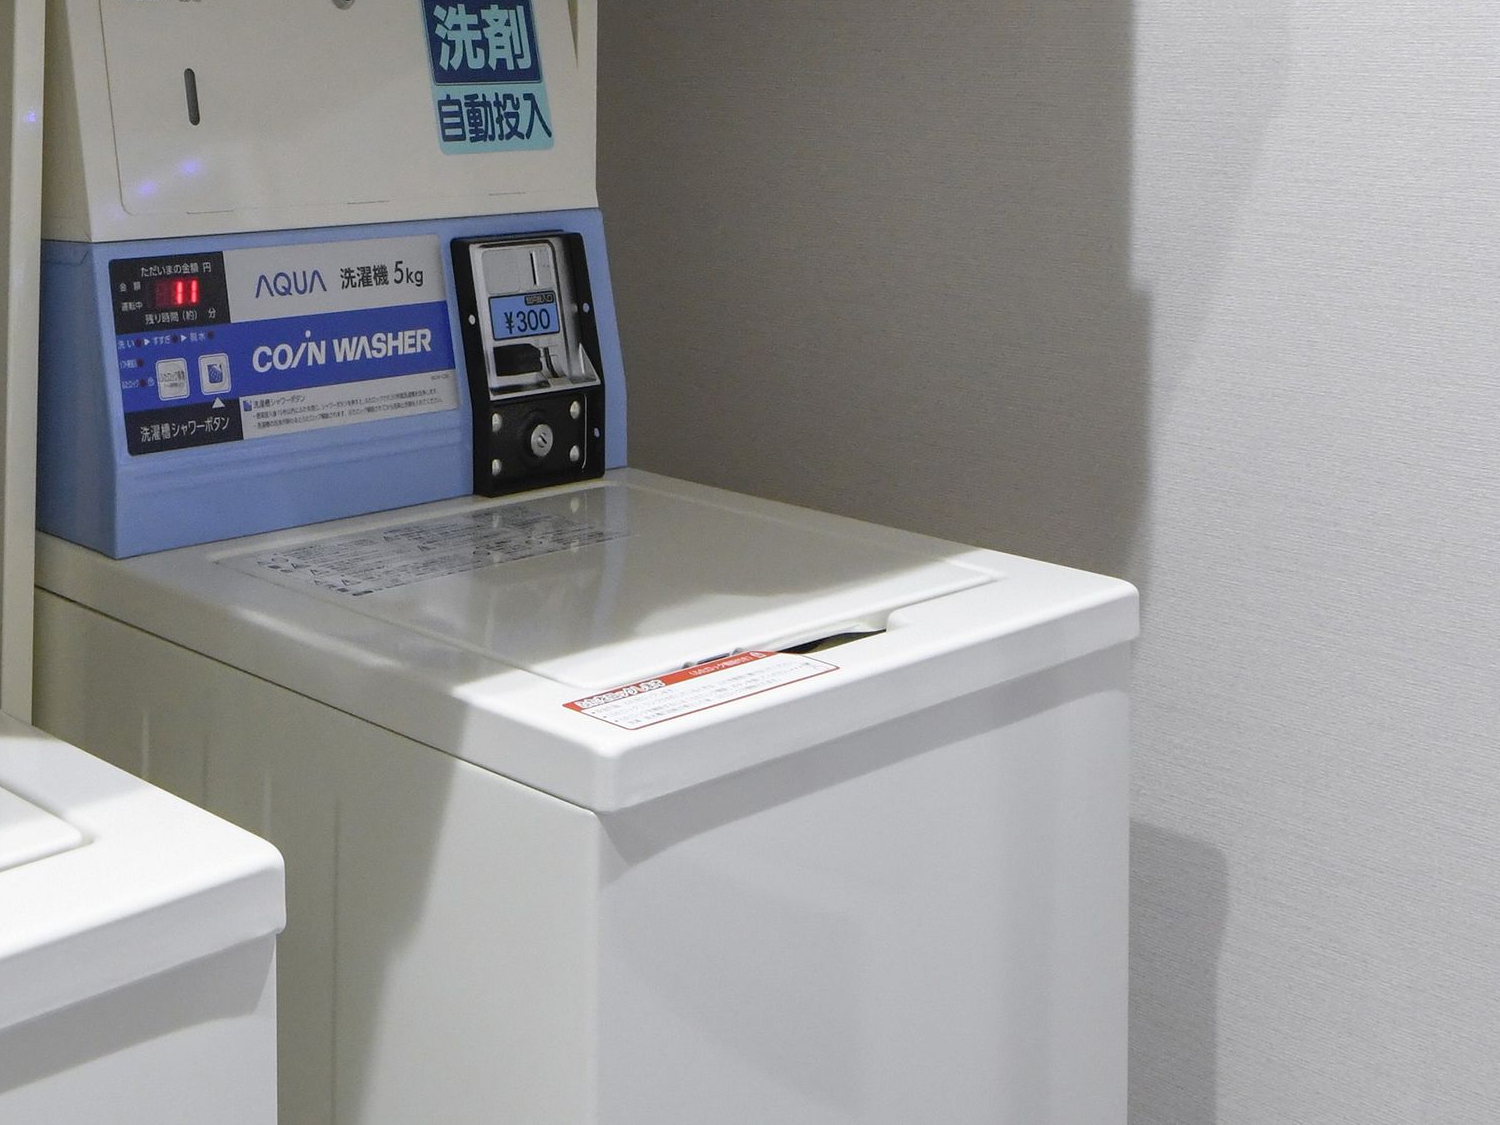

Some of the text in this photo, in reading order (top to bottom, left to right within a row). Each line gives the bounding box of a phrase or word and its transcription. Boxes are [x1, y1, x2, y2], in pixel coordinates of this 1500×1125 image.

[433, 3, 532, 71] 洗剤
[437, 92, 552, 143] 自動投入
[141, 262, 212, 278] ただいまの金額 円
[255, 260, 424, 298] AQUA 洗濯機 5kg
[504, 309, 550, 334] ¥300
[252, 328, 432, 373] COIN WASHER
[141, 417, 230, 443] 洗濯槽シャワーボタン
